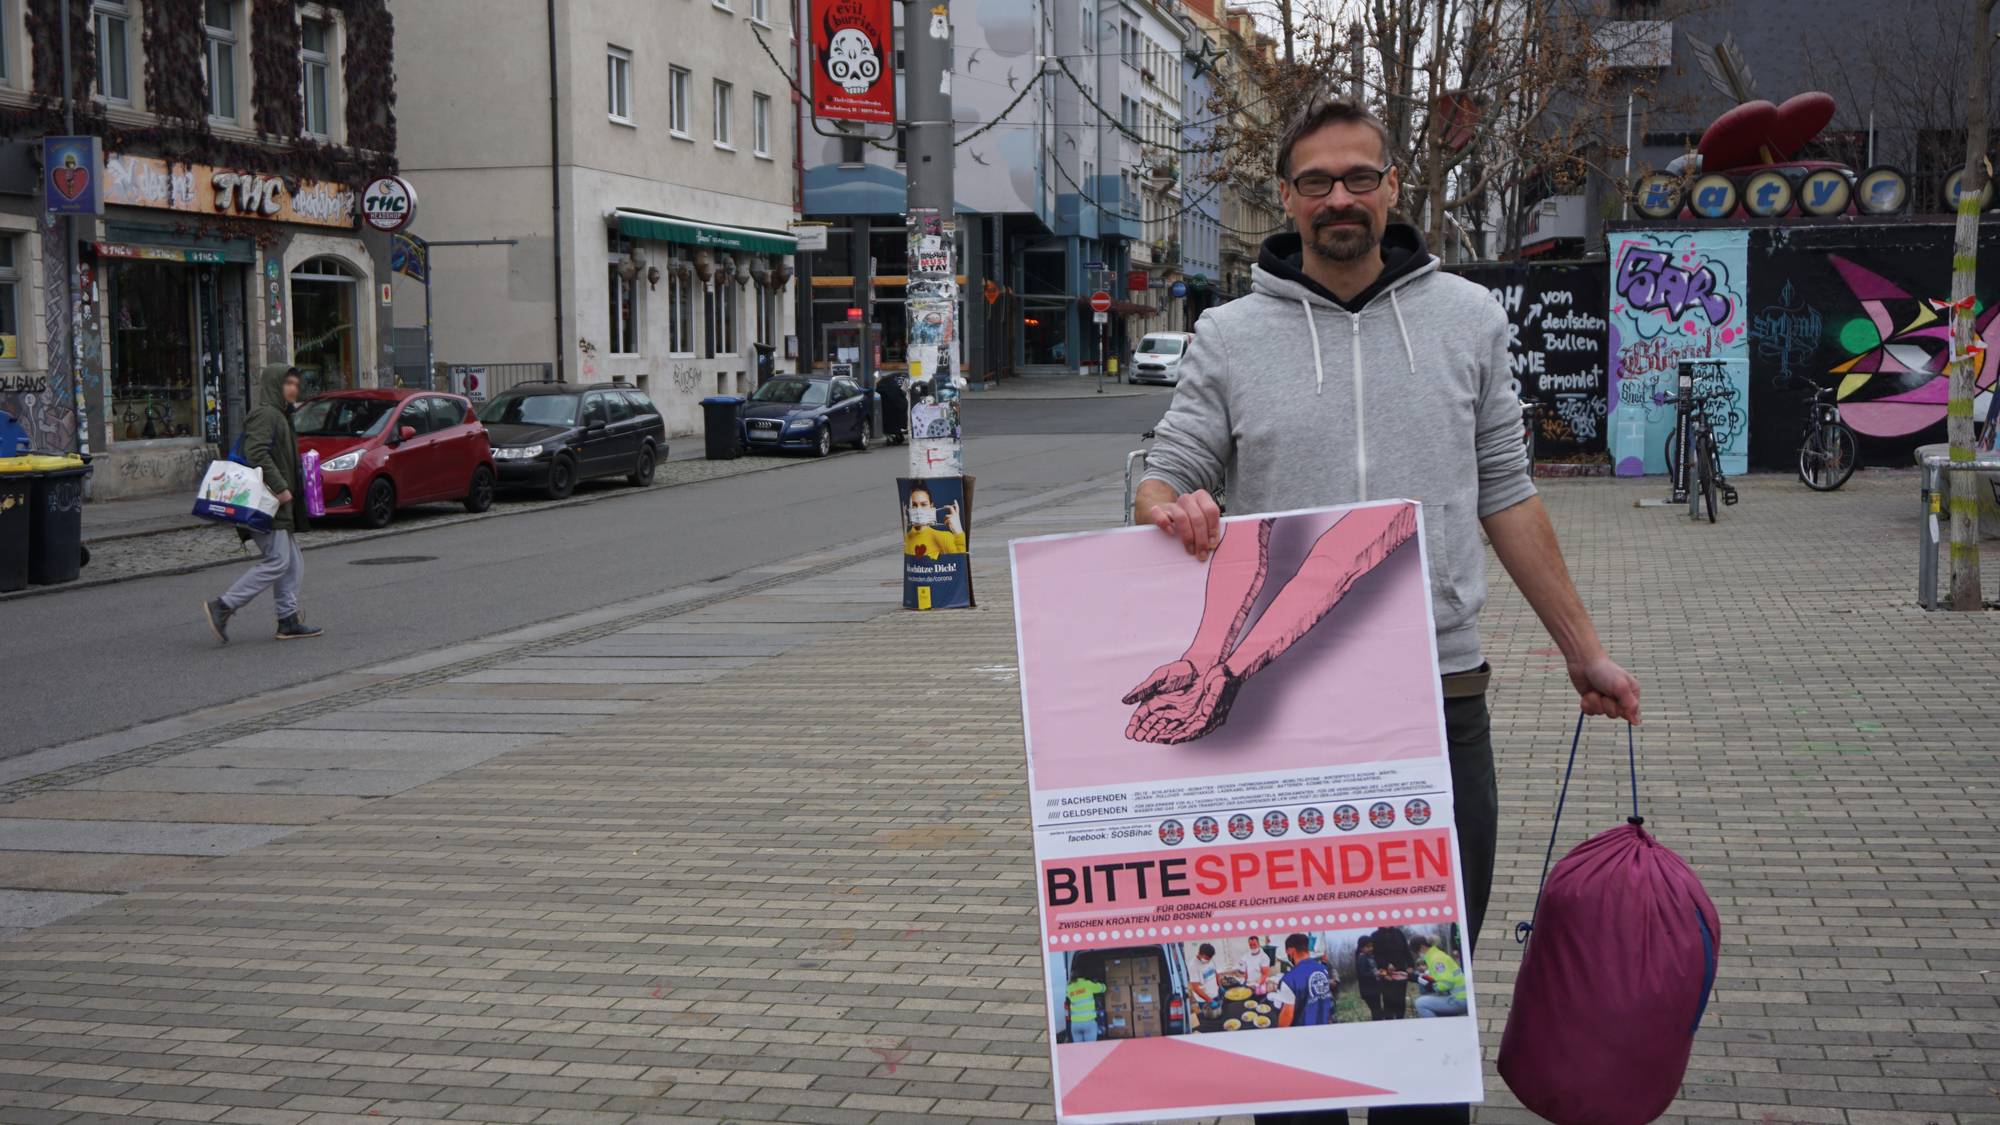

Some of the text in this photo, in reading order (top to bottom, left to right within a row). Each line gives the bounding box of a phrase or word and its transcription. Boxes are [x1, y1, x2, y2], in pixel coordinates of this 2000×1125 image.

[211, 171, 283, 216] THC
[366, 196, 405, 212] THC
[1540, 290, 1573, 305] von
[1541, 309, 1606, 331] deutschen
[1542, 333, 1598, 351] Bullen
[934, 563, 957, 573] Dich!
[1061, 793, 1127, 806] SACHSPENDEN
[1063, 806, 1128, 818] GELDSPENDEN
[1068, 830, 1109, 842] facebook:
[1111, 828, 1153, 839] SOSBihac
[1156, 884, 1447, 913] FÜR OBDACHLOSE FLÜCHTLINGE AN DER EUROPÄISCHEN GRENZE
[1058, 911, 1212, 930] ZWISCHEN KROATIEN UND BOSNIEN
